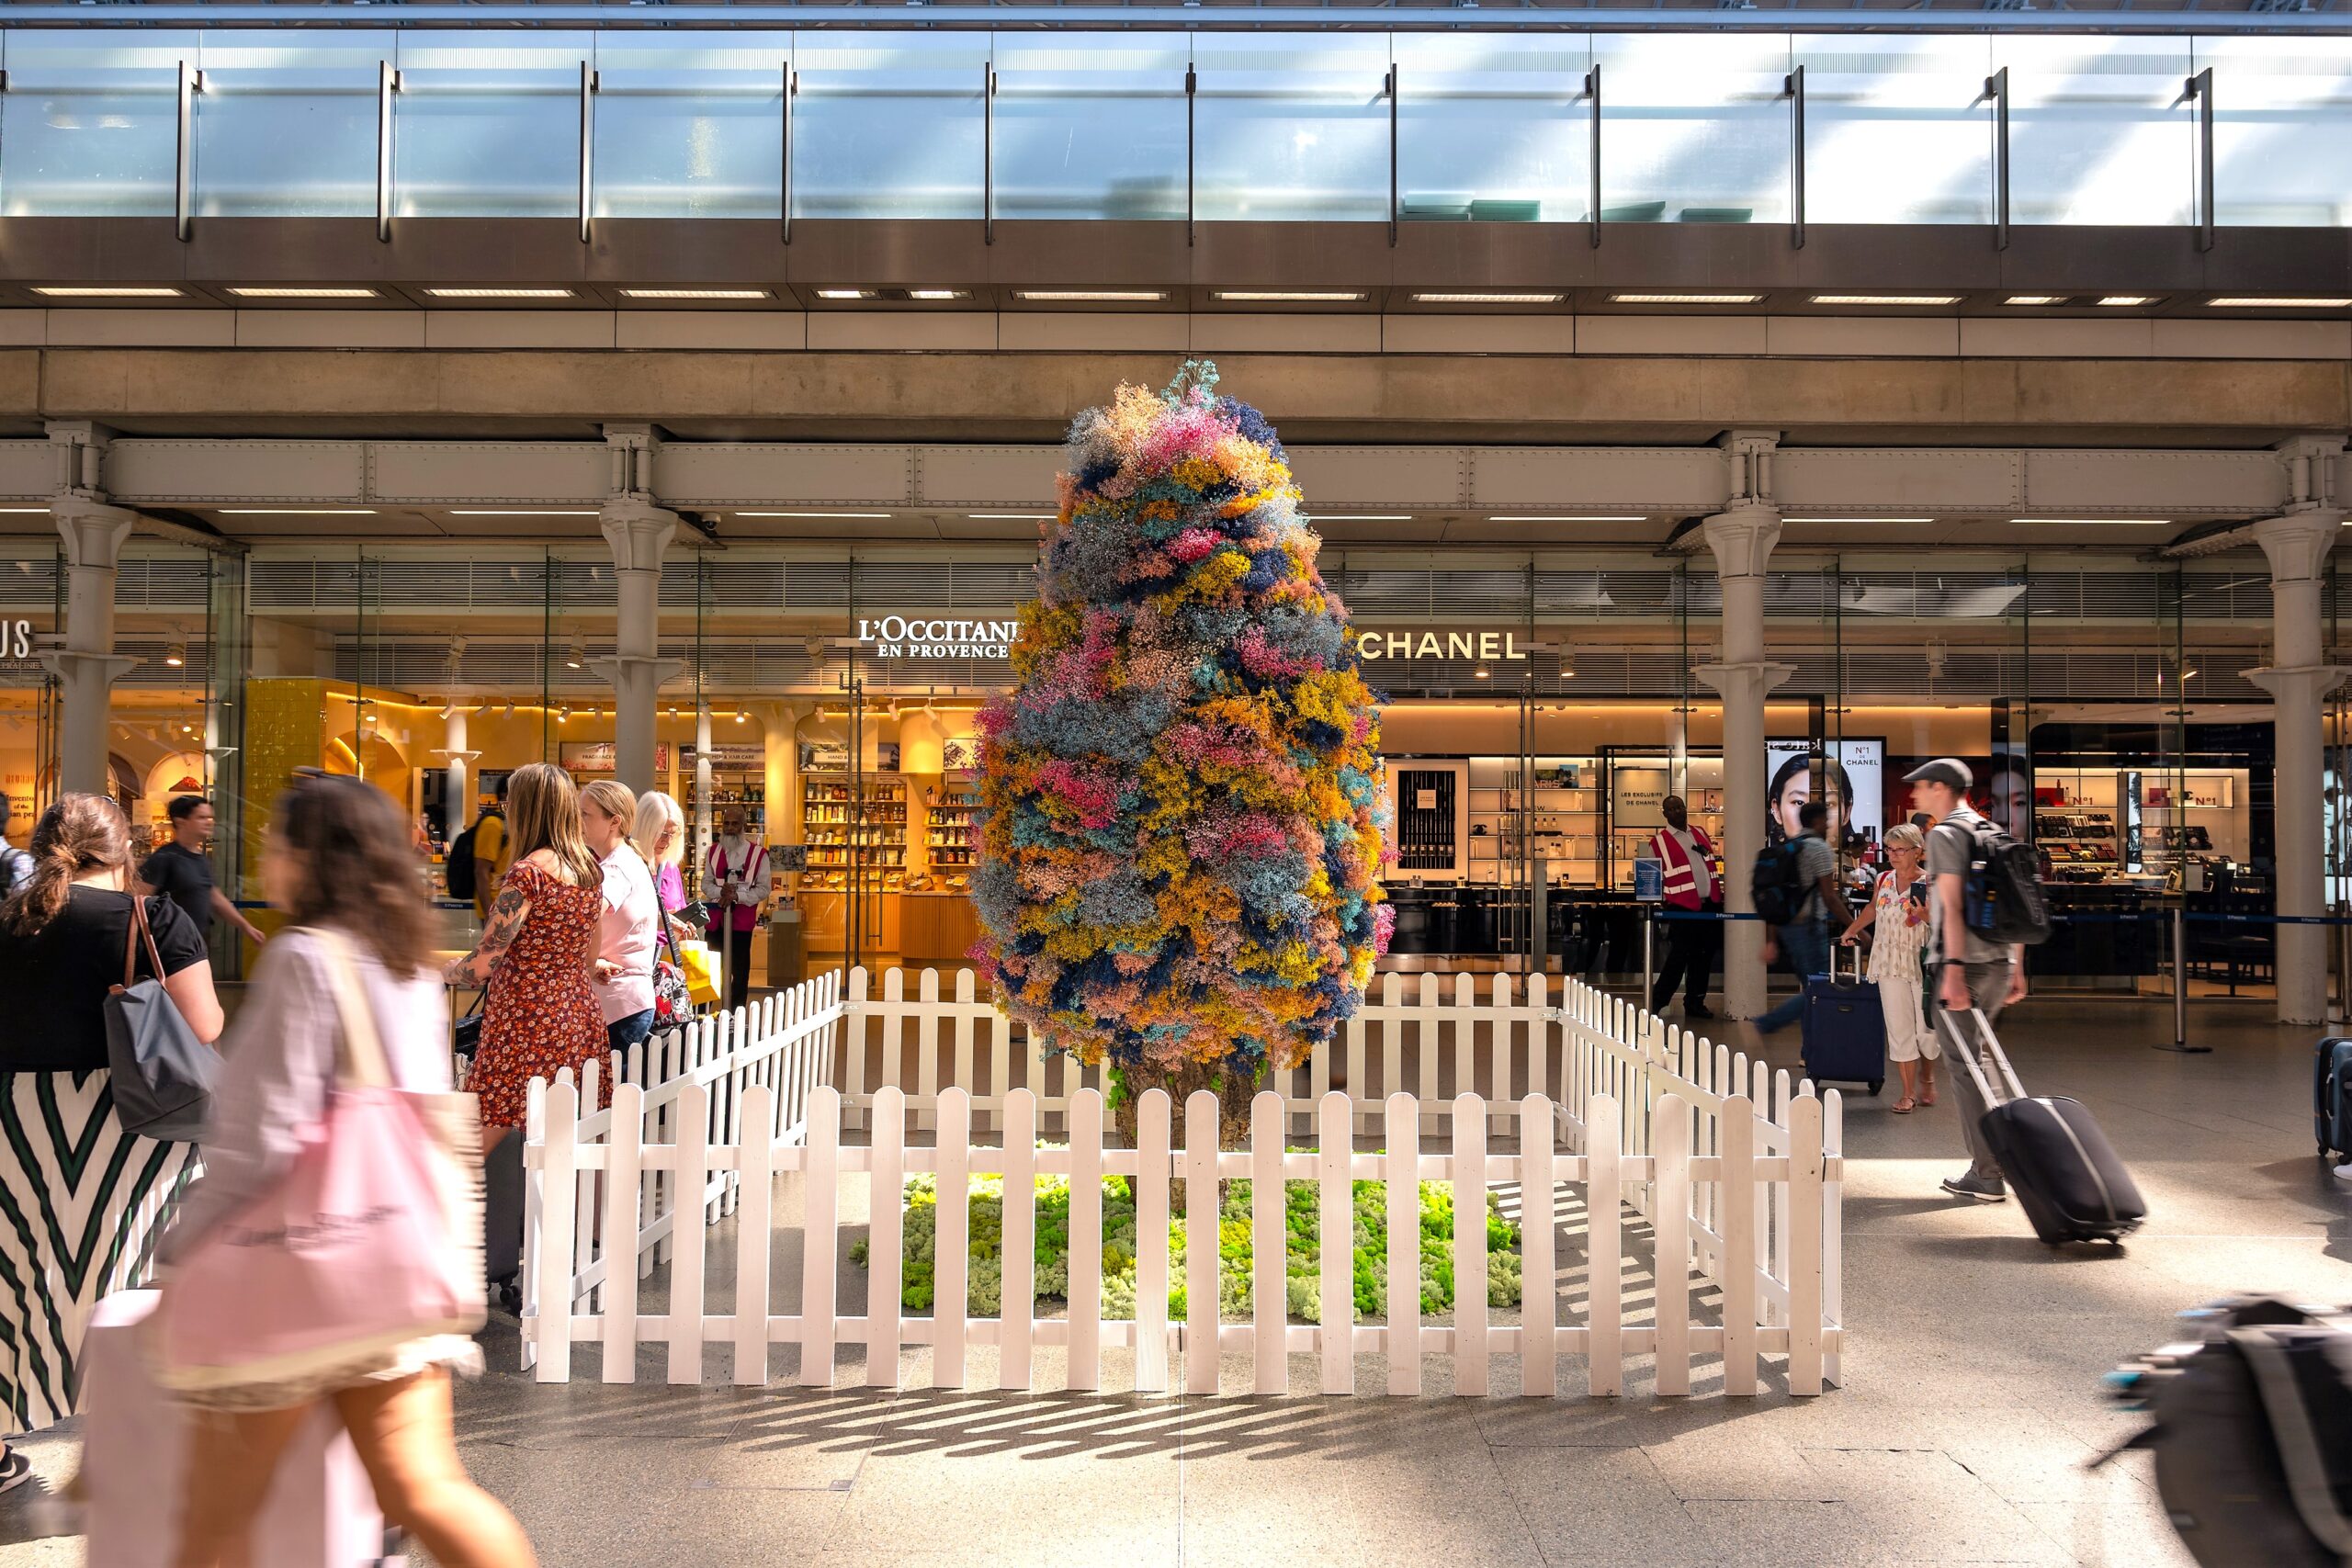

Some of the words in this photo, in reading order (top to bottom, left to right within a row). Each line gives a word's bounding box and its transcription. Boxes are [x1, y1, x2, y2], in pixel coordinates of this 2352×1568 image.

[877, 645, 901, 658] EN
[909, 645, 1009, 658] PROVENCE
[1358, 631, 1526, 660] CHANEL
